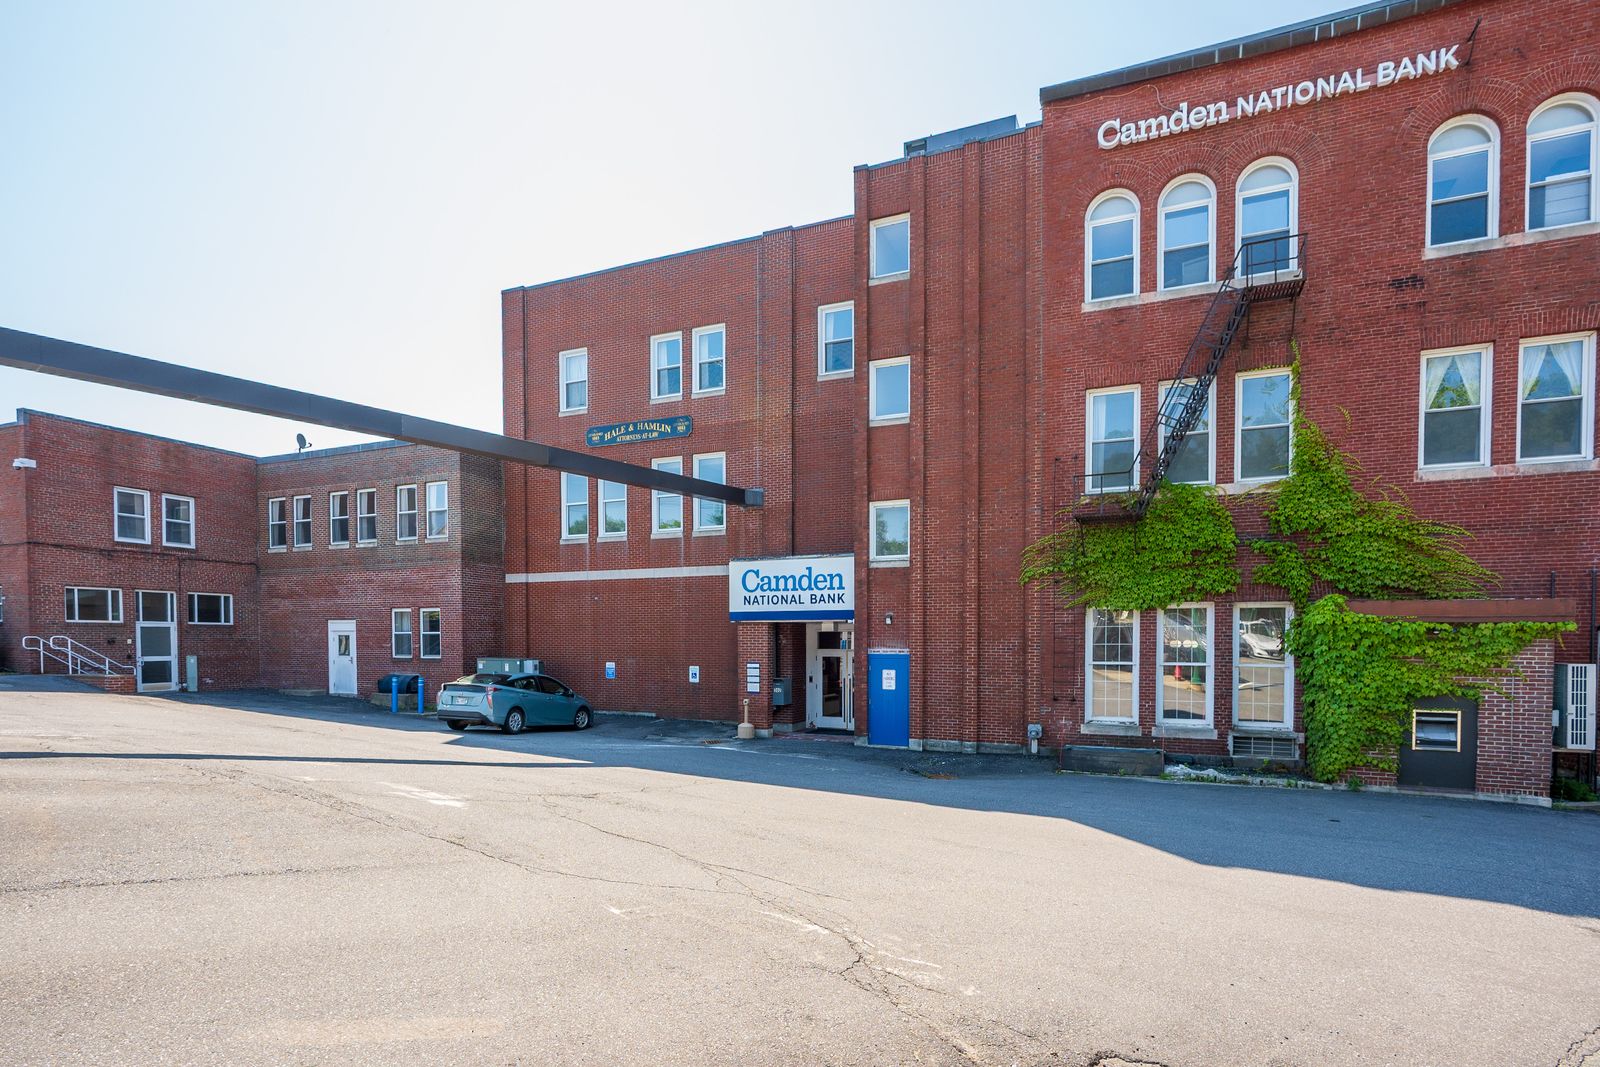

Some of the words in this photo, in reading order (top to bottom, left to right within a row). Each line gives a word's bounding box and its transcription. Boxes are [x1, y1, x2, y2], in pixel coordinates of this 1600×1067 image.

[1097, 101, 1230, 149] Camden
[1236, 67, 1372, 119] NATIONAL
[1376, 44, 1461, 88] BANK
[604, 425, 626, 441] HALE
[628, 423, 634, 432] &
[637, 422, 671, 434] HAMLIN
[741, 566, 846, 593] Camden
[743, 594, 805, 606] NATIONAL
[810, 593, 846, 605] BANK
